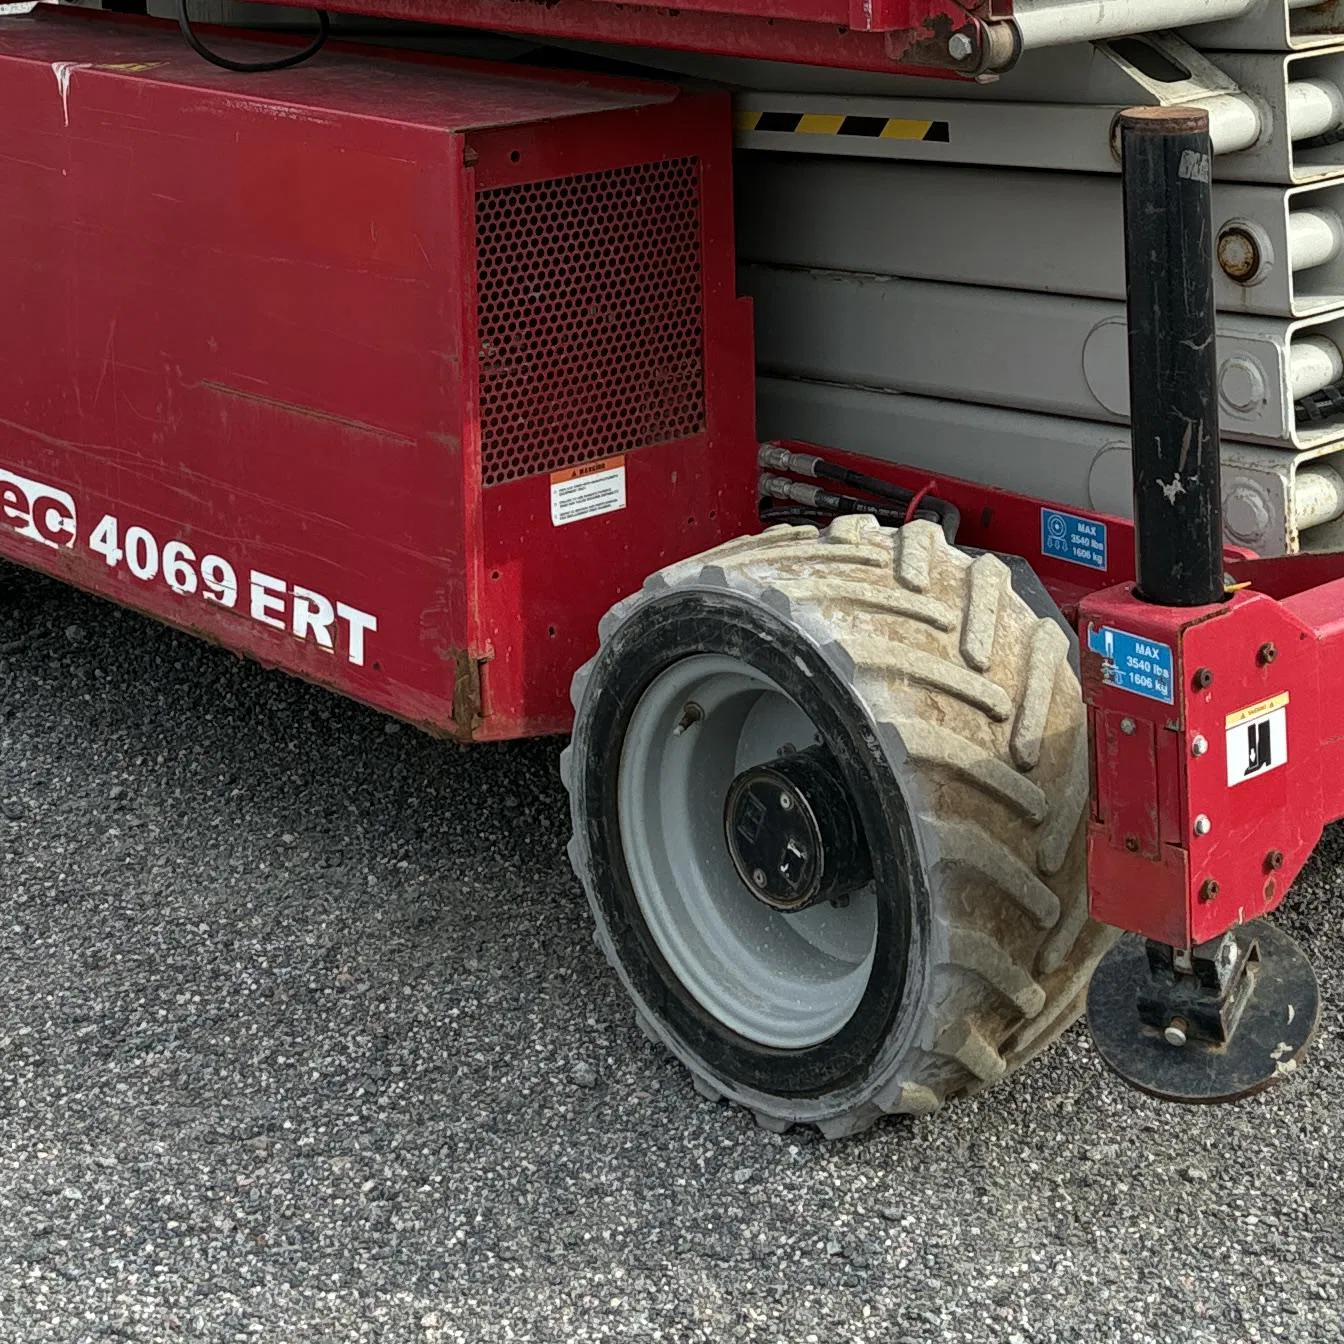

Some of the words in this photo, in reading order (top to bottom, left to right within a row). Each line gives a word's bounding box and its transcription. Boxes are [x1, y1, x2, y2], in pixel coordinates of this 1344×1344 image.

[1077, 522, 1097, 536] MAX
[89, 513, 239, 608] 4069
[248, 569, 378, 667] ERT
[1135, 642, 1160, 660] MAX
[1126, 655, 1151, 672] 3540
[1152, 661, 1169, 678] lbs
[1129, 673, 1153, 688] 1606
[1154, 679, 1169, 696] kg
